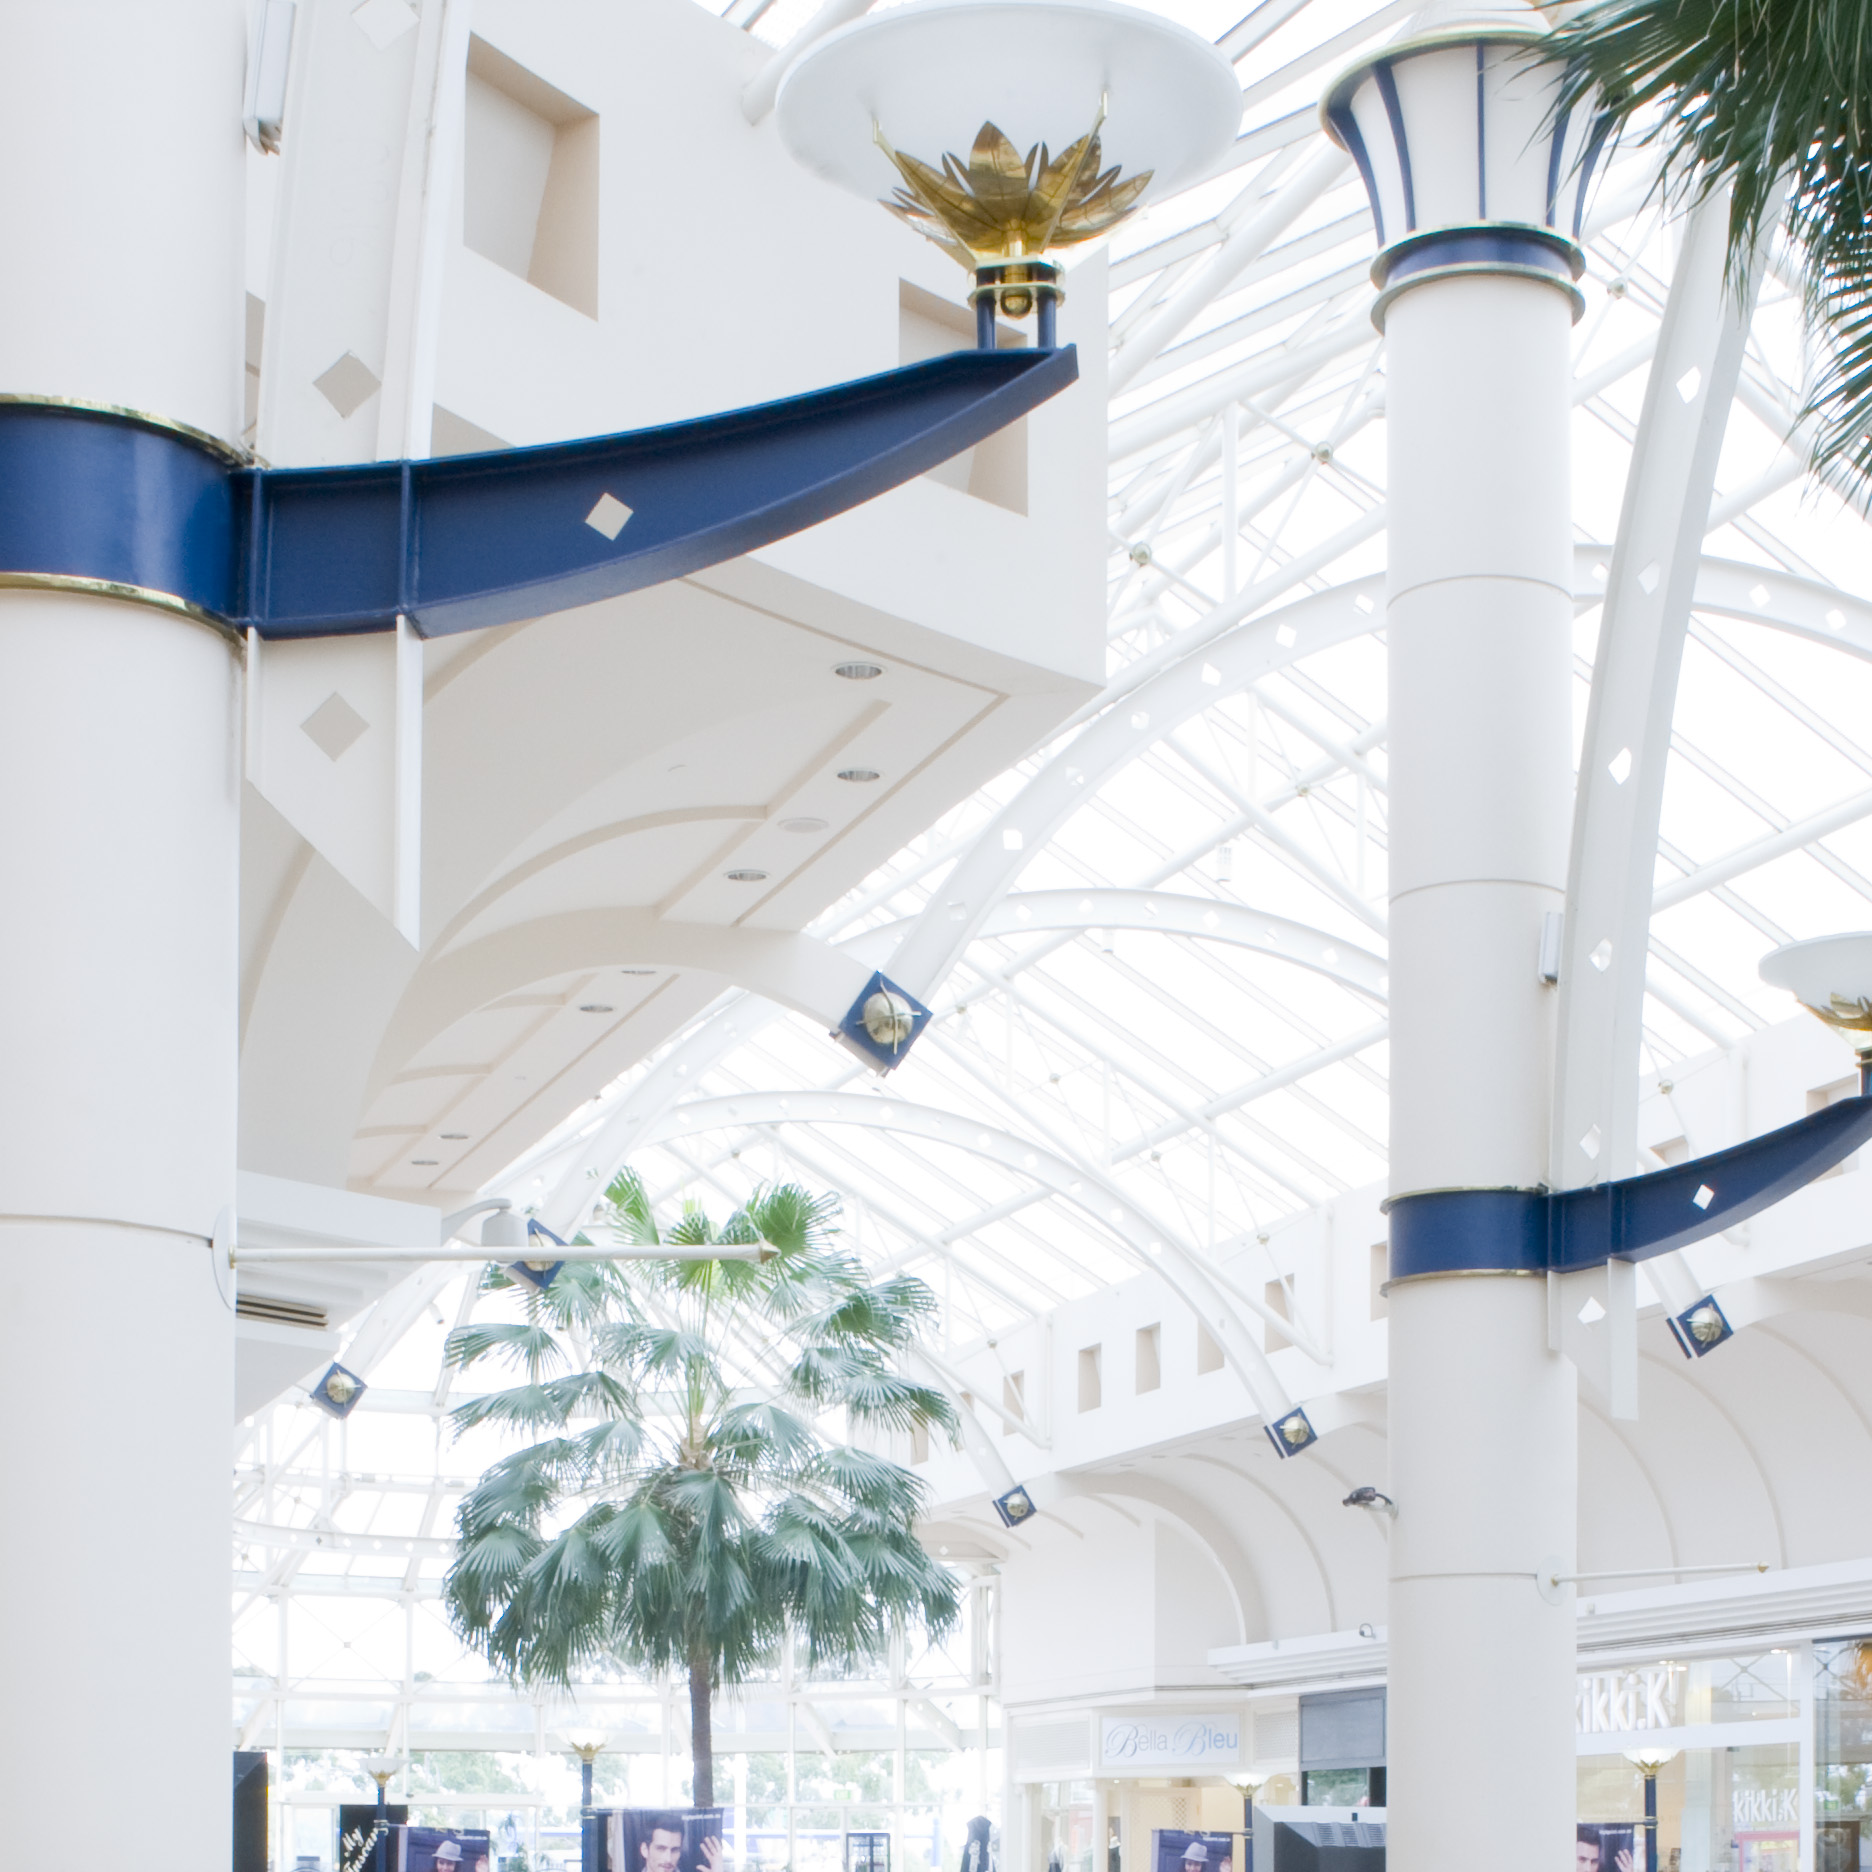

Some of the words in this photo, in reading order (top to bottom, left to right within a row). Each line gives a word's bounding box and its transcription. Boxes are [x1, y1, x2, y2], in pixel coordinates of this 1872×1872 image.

[1105, 1723, 1168, 1758] Bella
[1172, 1721, 1238, 1756] Bleu
[1733, 1788, 1797, 1823] kikki.K
